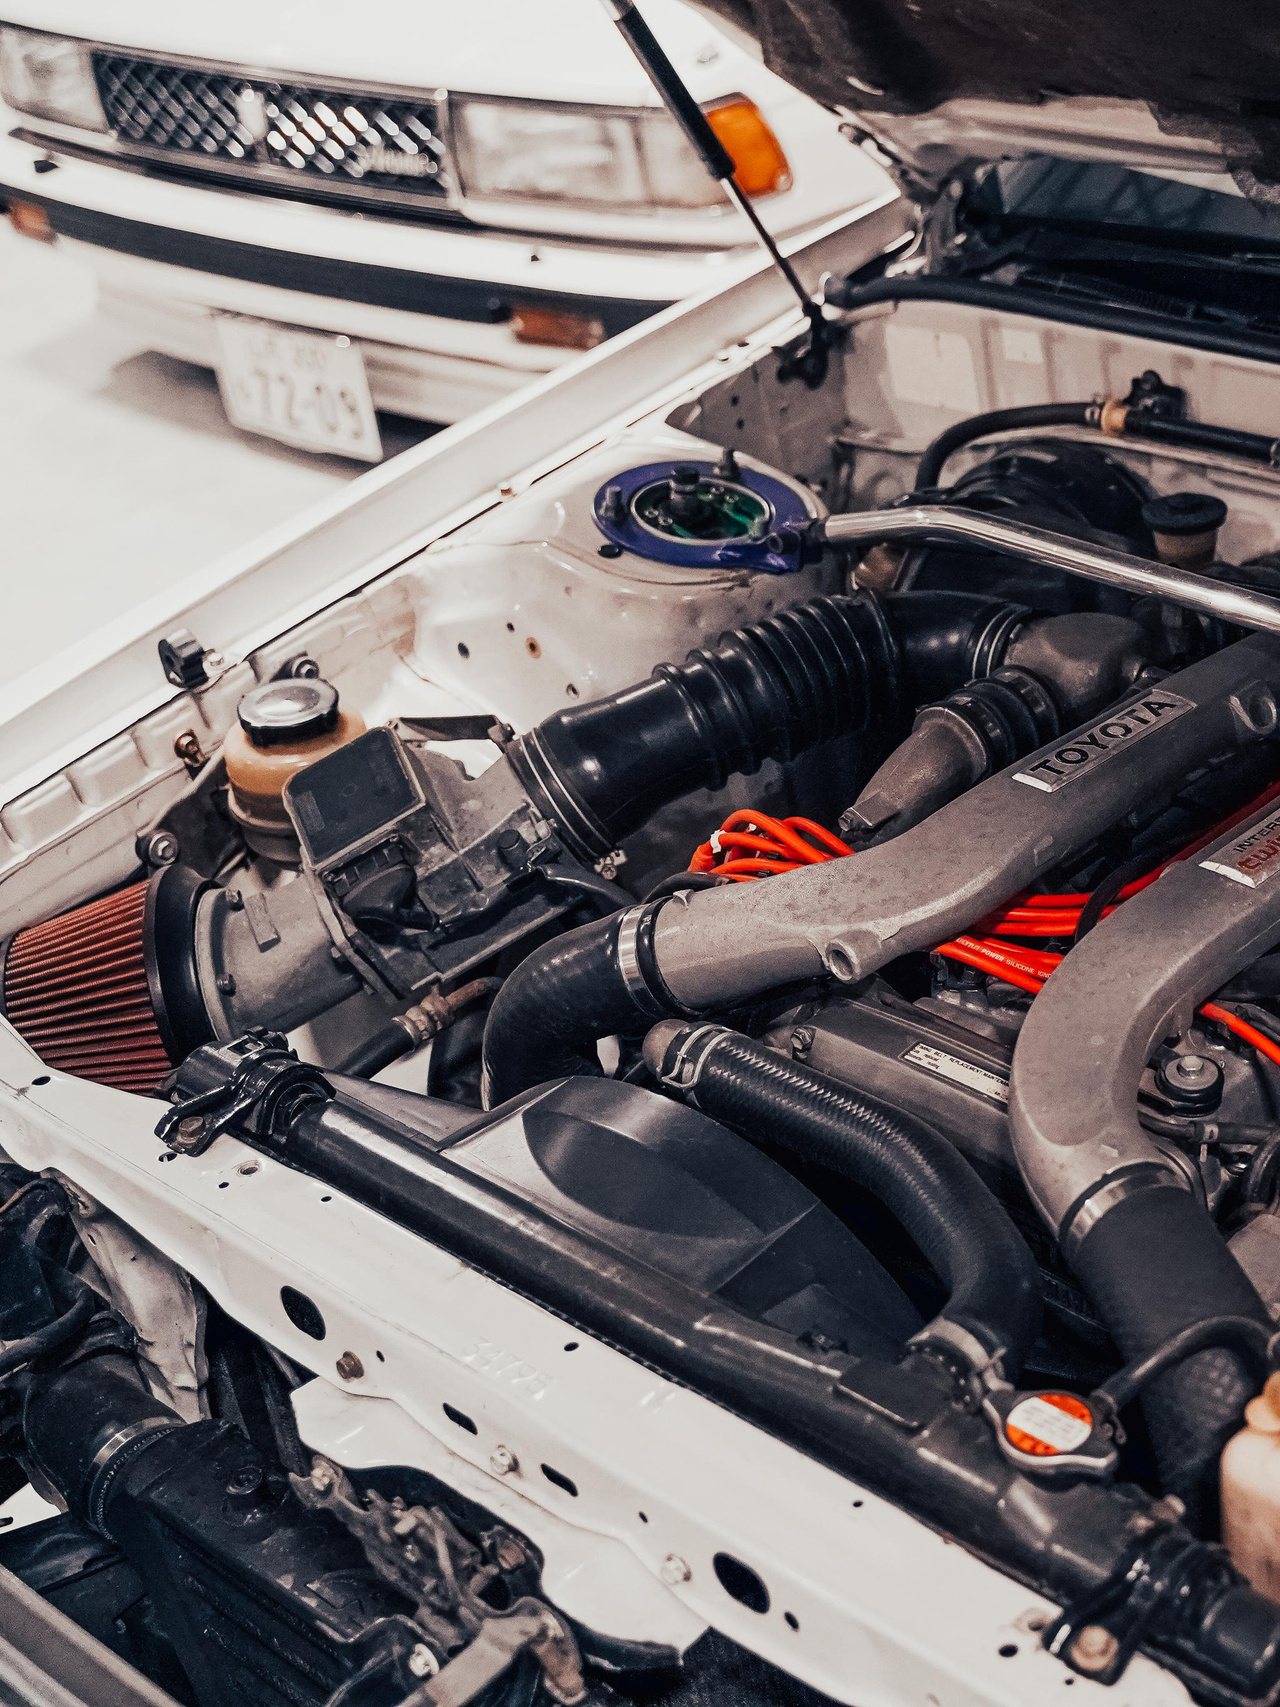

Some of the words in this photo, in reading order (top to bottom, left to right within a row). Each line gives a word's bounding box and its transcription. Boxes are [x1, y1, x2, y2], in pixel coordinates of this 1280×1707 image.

[1029, 700, 1177, 776] TOYOTA
[981, 947, 1005, 962] POWER
[1006, 959, 1035, 974] SILICONE
[933, 1050, 947, 1058] BELT
